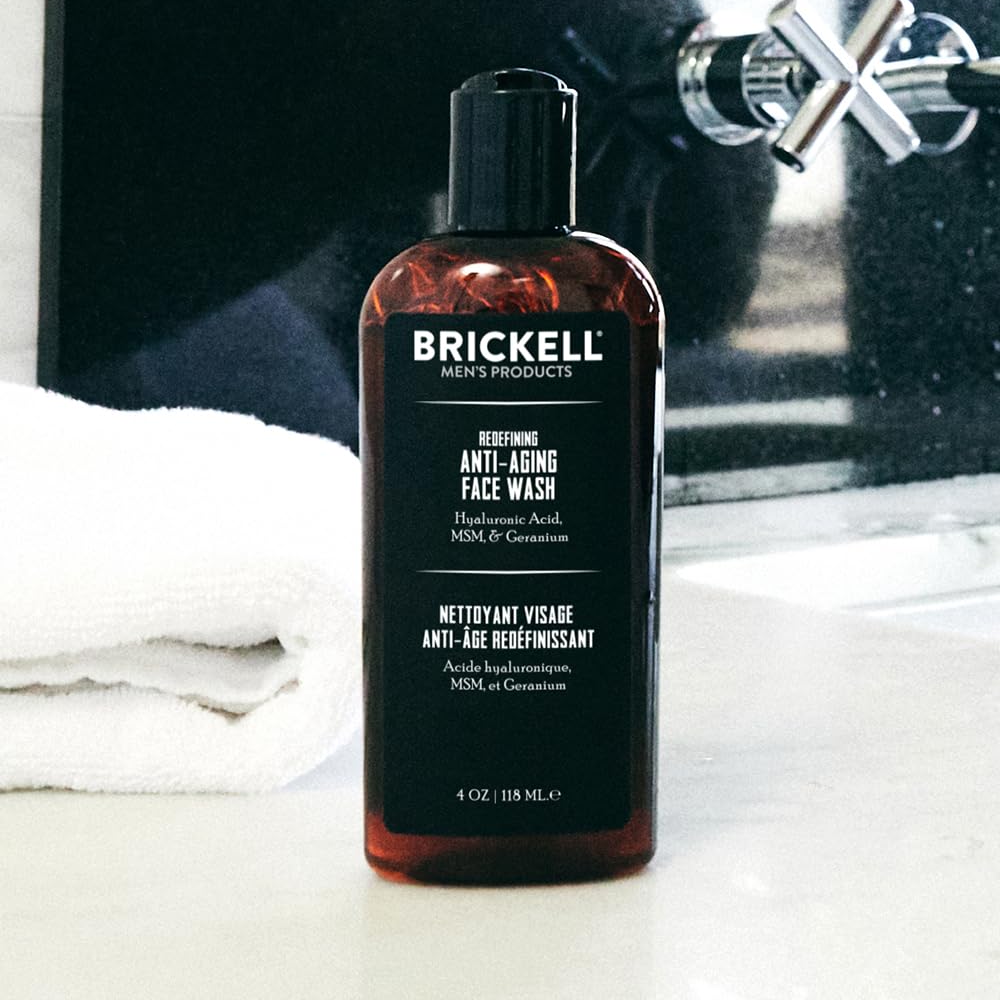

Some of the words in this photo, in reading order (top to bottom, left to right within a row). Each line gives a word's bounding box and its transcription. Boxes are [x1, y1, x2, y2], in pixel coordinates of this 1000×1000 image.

[413, 329, 603, 363] BRICKELL
[440, 365, 488, 379] MEN'S
[491, 365, 573, 379] PRODUCTS
[478, 430, 539, 447] REDEFINING
[459, 449, 558, 474] ANTI-AGING
[461, 476, 501, 501] FACE
[506, 476, 556, 501] WASH
[454, 511, 526, 527] Hyaluronic
[528, 511, 563, 526] Acid,
[450, 529, 487, 544] MSM,
[488, 529, 503, 543] &
[505, 529, 569, 543] Geranium
[439, 604, 519, 625] NETTOYANT
[523, 604, 574, 625] VISAGE
[422, 625, 488, 649] ANTI-ÂGE
[492, 625, 595, 650] REDÉFINISSANT
[443, 659, 482, 674] Acide
[484, 659, 572, 675] hyaluronique,
[450, 677, 486, 692] MSM,
[488, 680, 501, 691] et
[503, 677, 566, 691] Geranium
[456, 788, 465, 801] 4
[468, 788, 490, 802] OZ
[501, 788, 521, 802] 118
